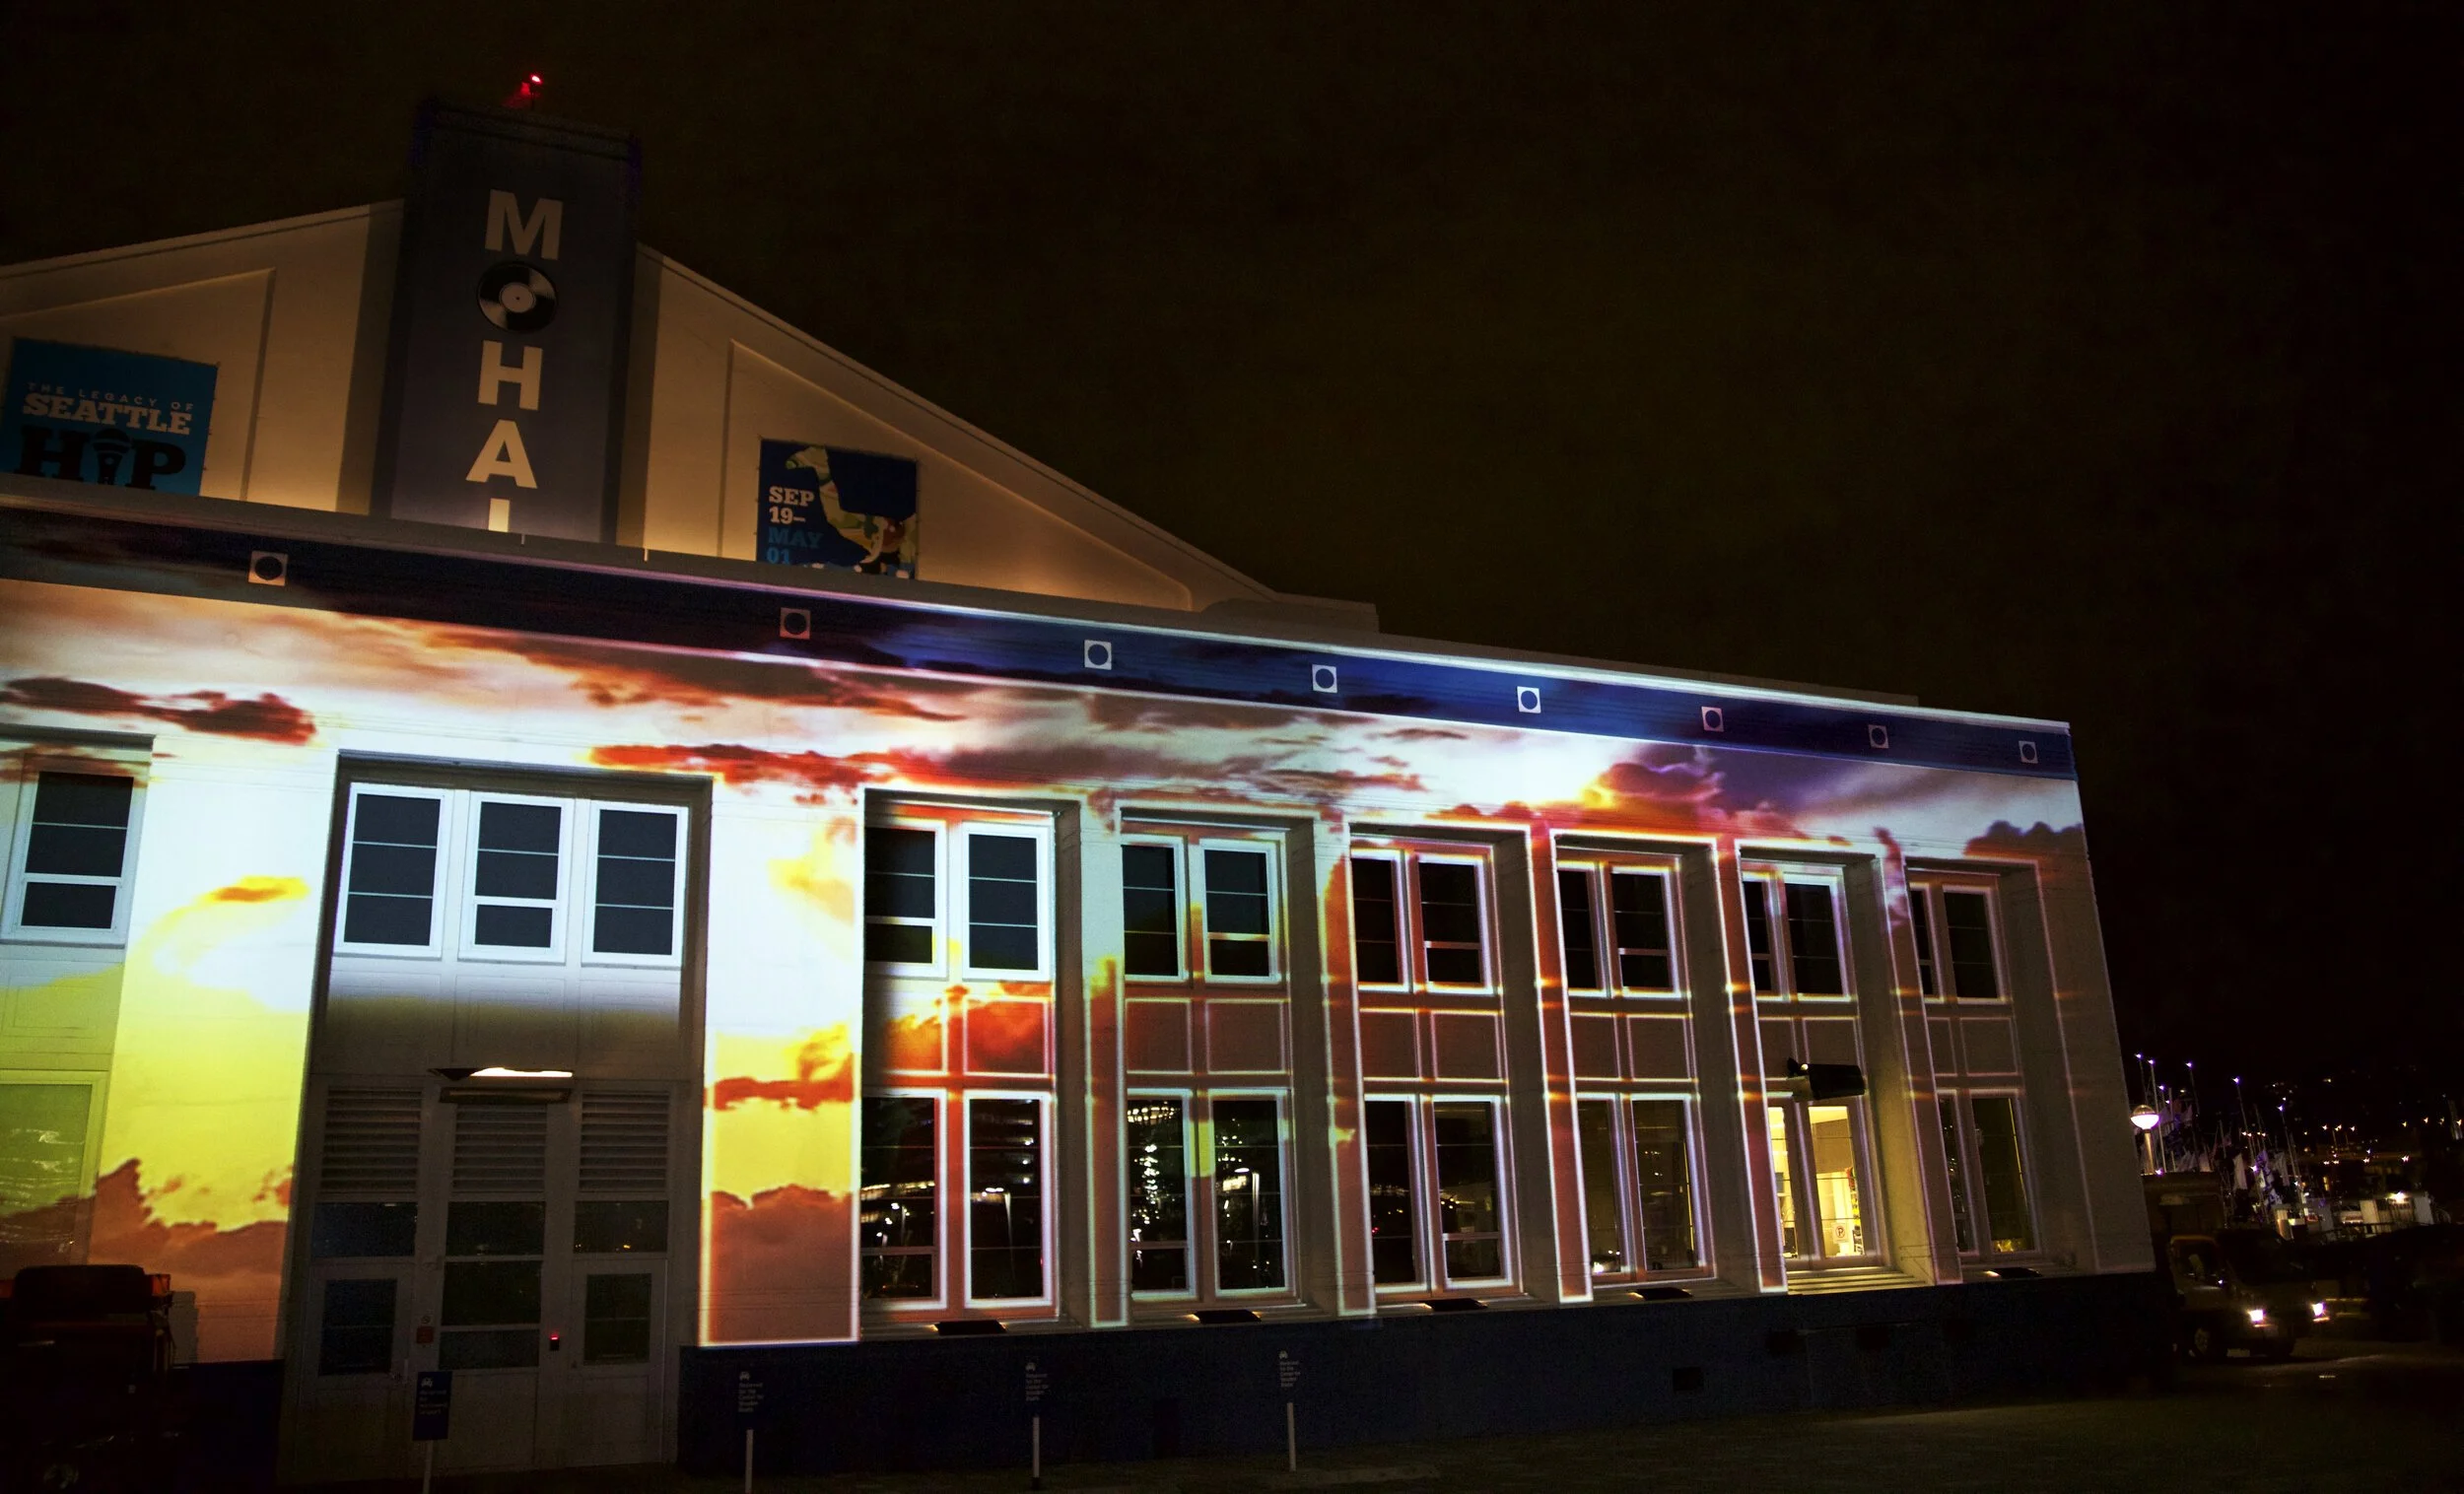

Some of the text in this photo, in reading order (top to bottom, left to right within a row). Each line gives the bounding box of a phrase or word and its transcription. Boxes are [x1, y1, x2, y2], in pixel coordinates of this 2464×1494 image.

[28, 382, 194, 412] THE LEGACY OF
[23, 392, 193, 435] SEATTLE
[768, 485, 815, 508] SEP
[768, 526, 824, 549] MAY
[766, 547, 791, 565] 01
